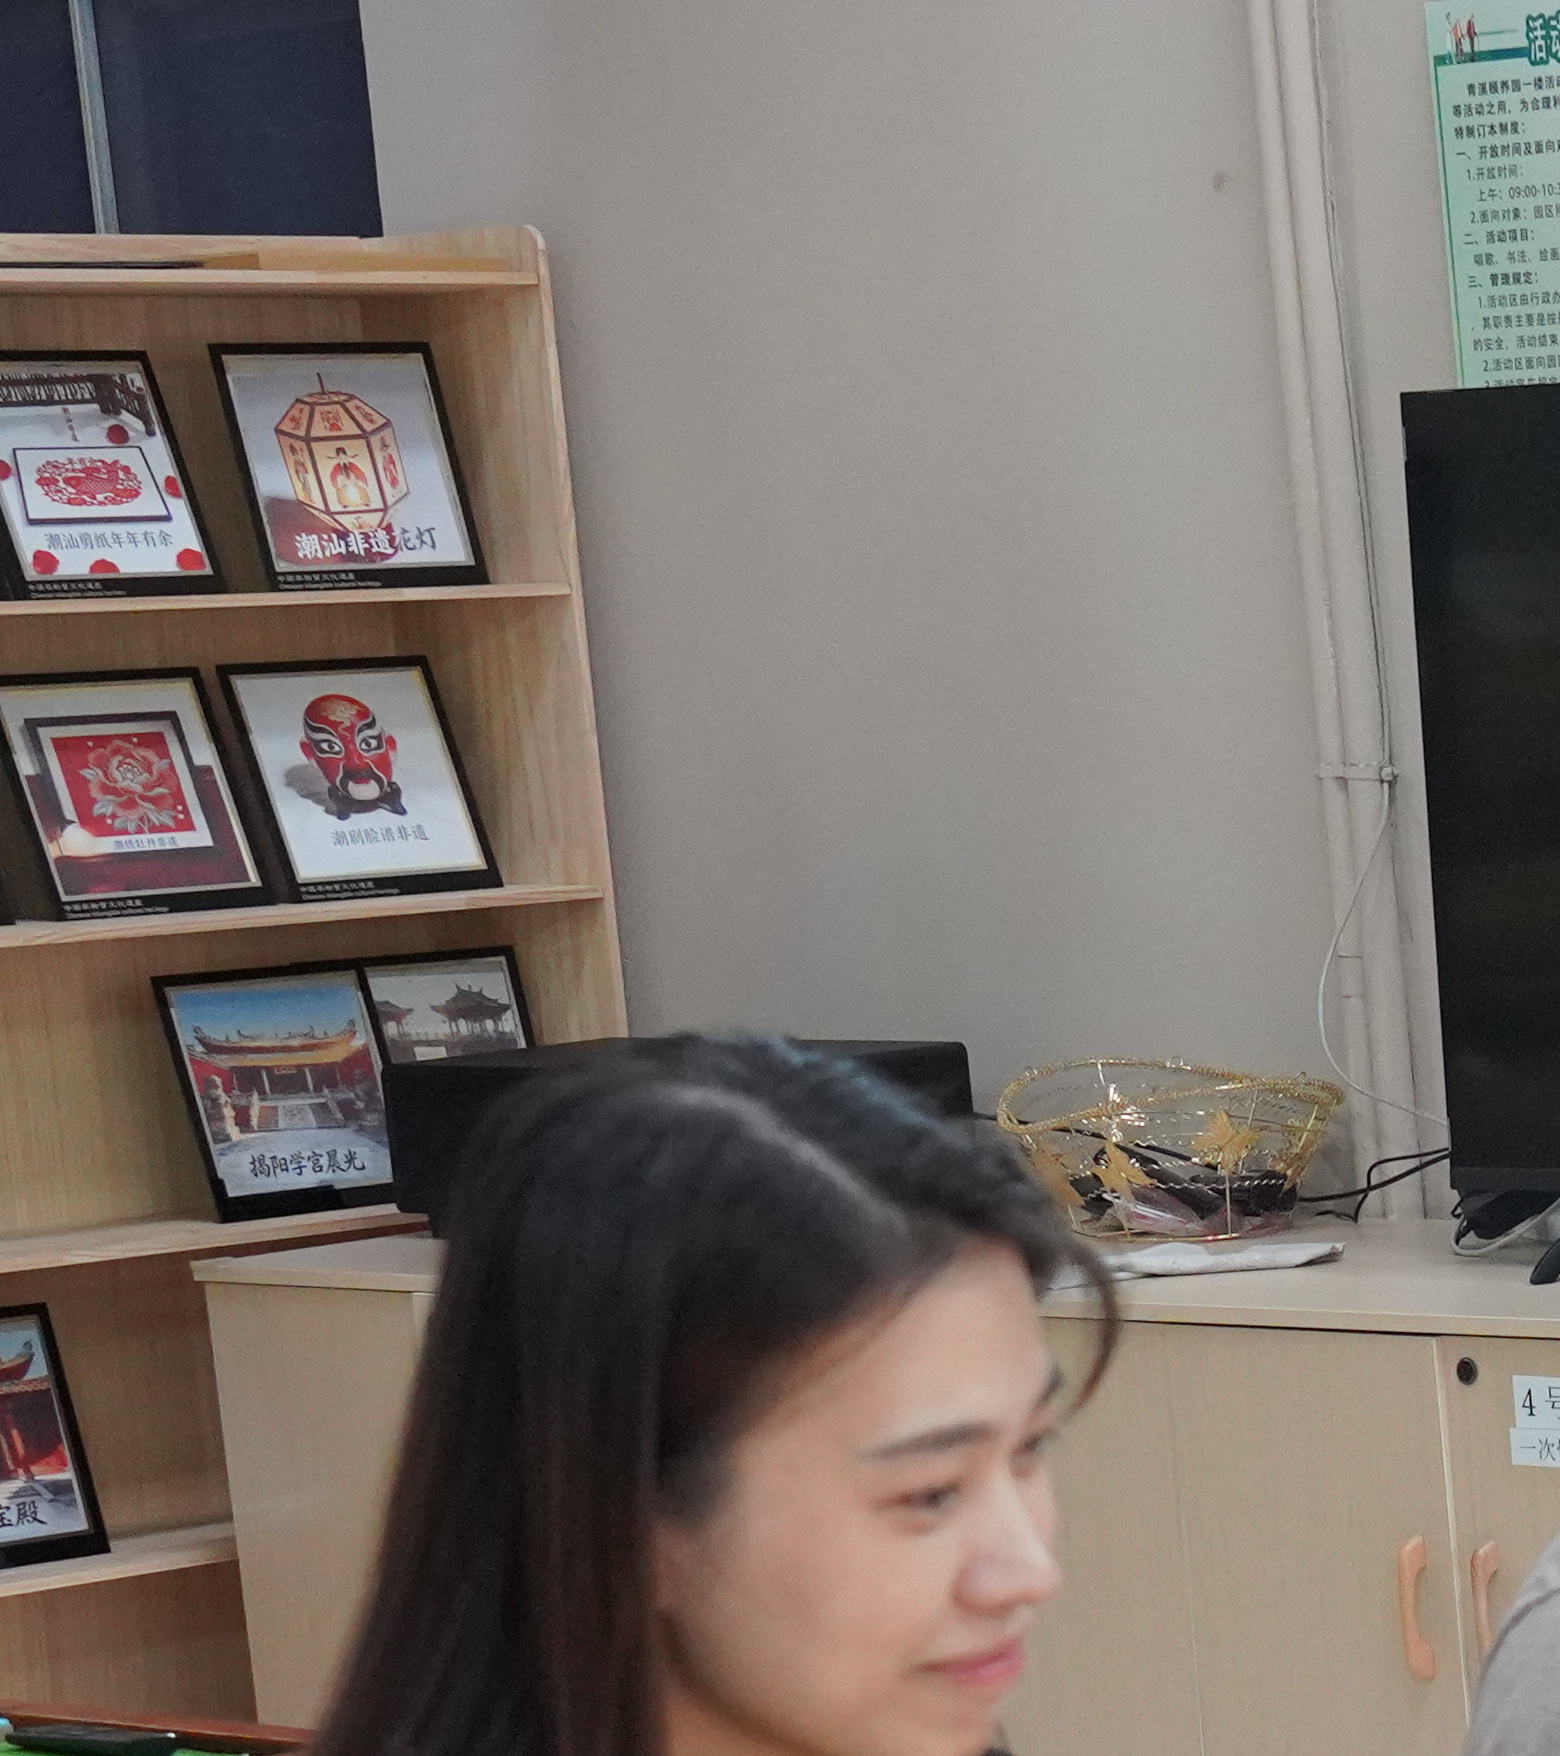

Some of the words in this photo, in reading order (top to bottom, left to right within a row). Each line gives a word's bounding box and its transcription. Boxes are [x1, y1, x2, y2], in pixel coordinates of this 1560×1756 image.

[44, 529, 174, 550] 潮汕剪纸年年有余
[295, 526, 437, 559] 潮汕非遗花灯
[249, 1149, 366, 1178] 揭阳学宫晨光
